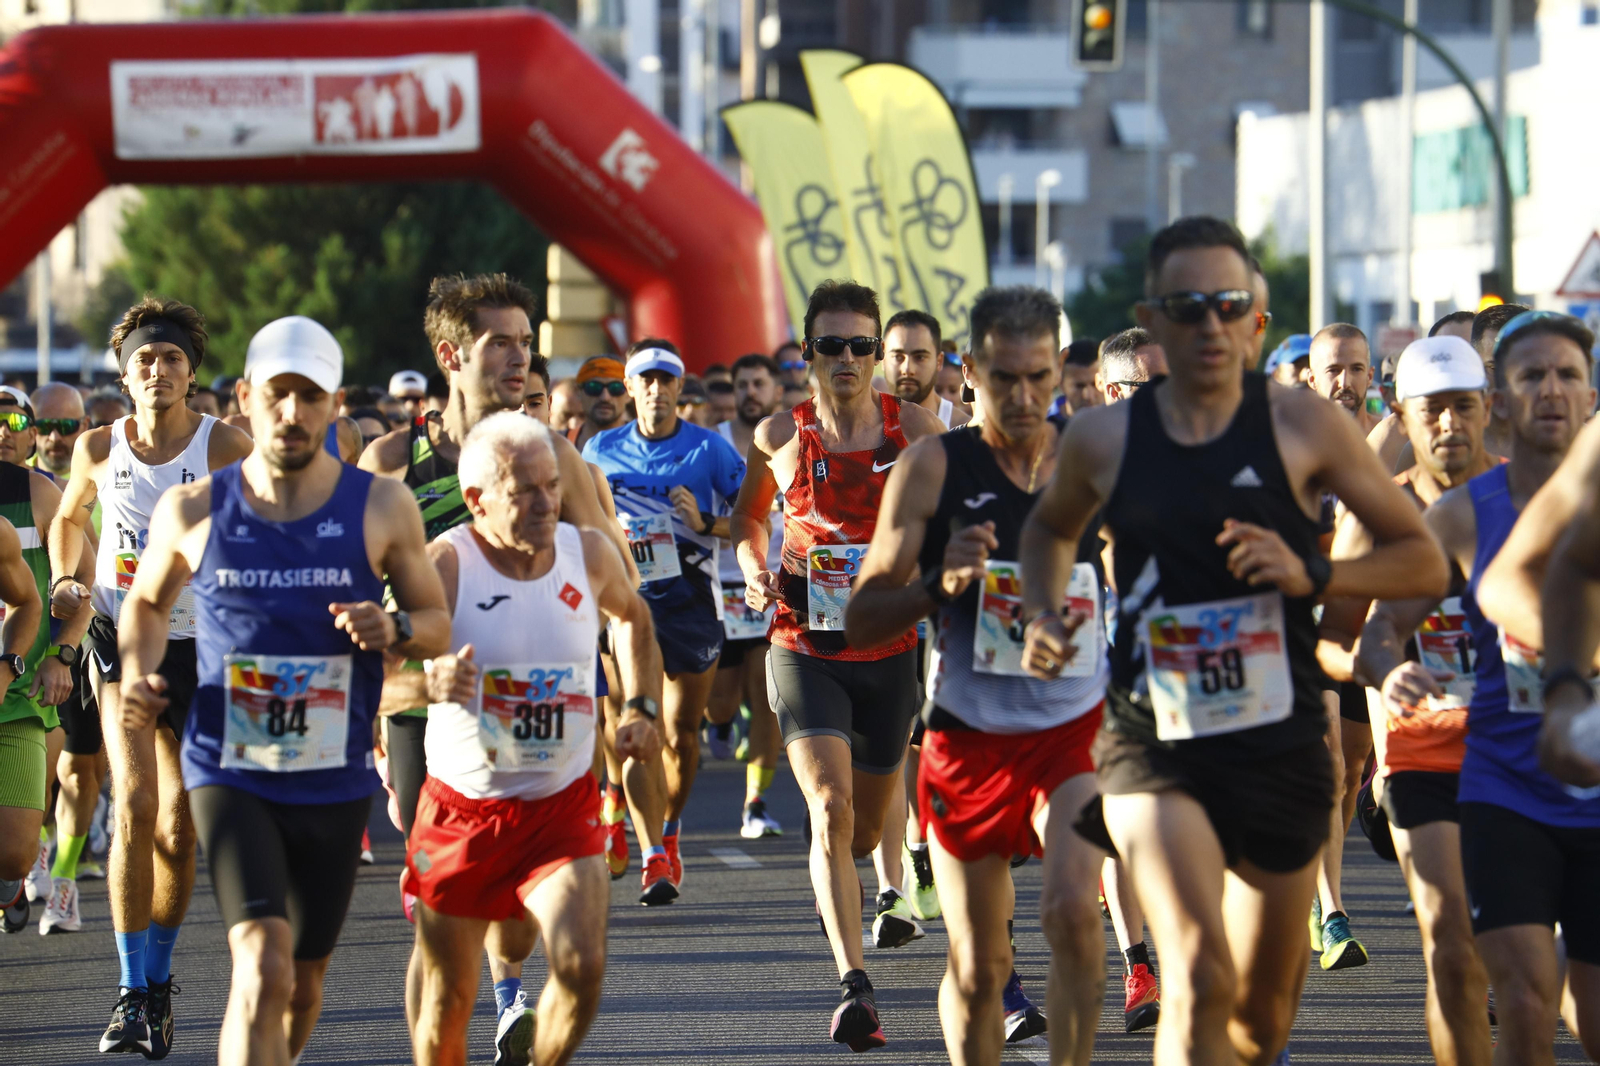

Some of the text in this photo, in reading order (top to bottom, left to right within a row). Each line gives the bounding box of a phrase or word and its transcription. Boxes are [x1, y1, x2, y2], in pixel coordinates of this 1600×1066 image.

[629, 540, 655, 564] 01
[215, 567, 352, 588] TROTASIERRA
[1198, 647, 1245, 695] 59
[267, 698, 308, 737] 84
[513, 703, 564, 740] 391
